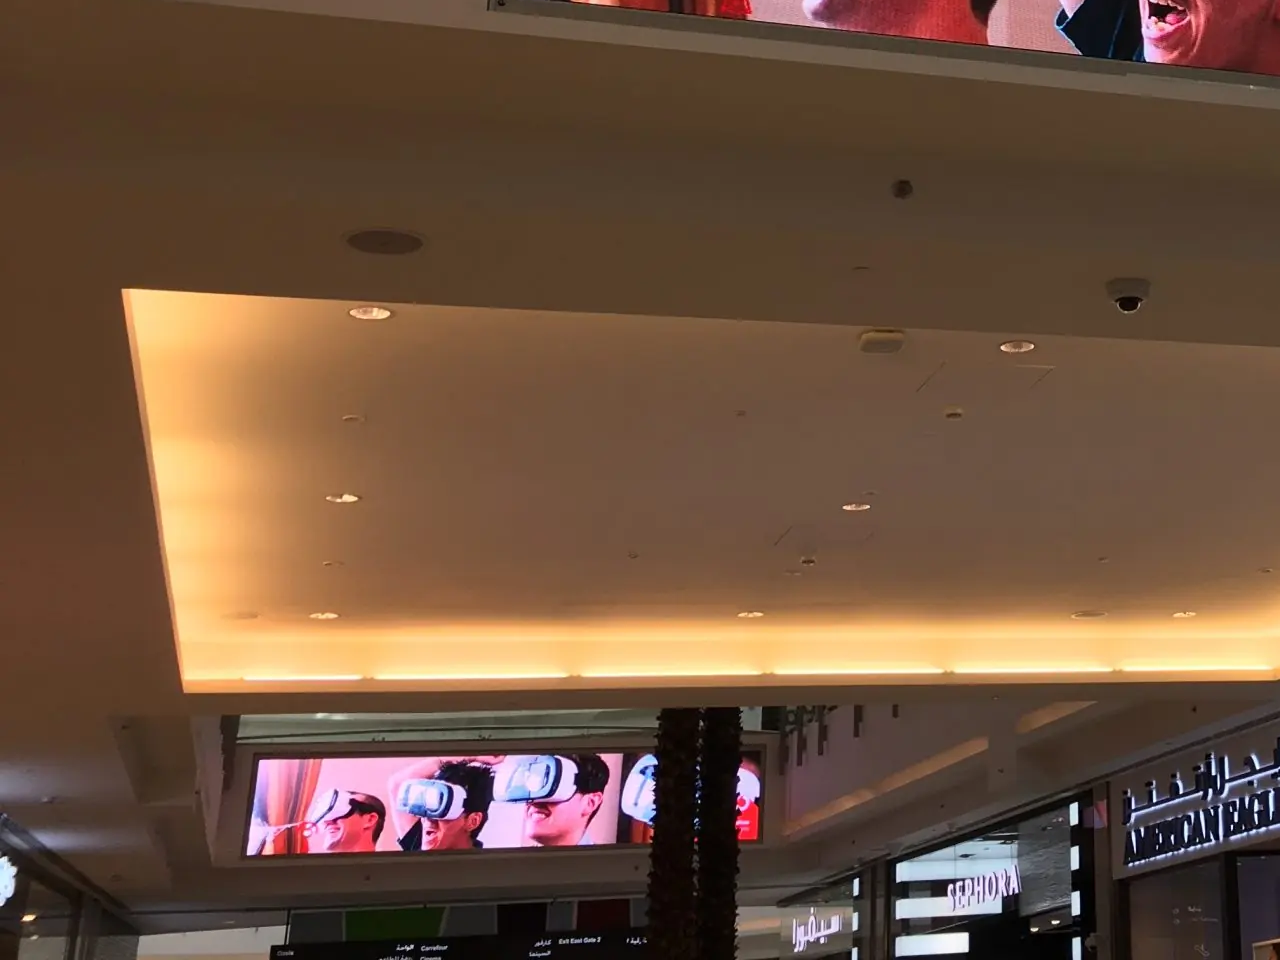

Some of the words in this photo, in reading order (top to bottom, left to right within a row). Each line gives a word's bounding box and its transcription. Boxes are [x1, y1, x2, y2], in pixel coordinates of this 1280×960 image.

[1122, 802, 1225, 867] AMERICAN
[947, 864, 1021, 912] SEPHORA
[420, 944, 448, 952] Carrefour
